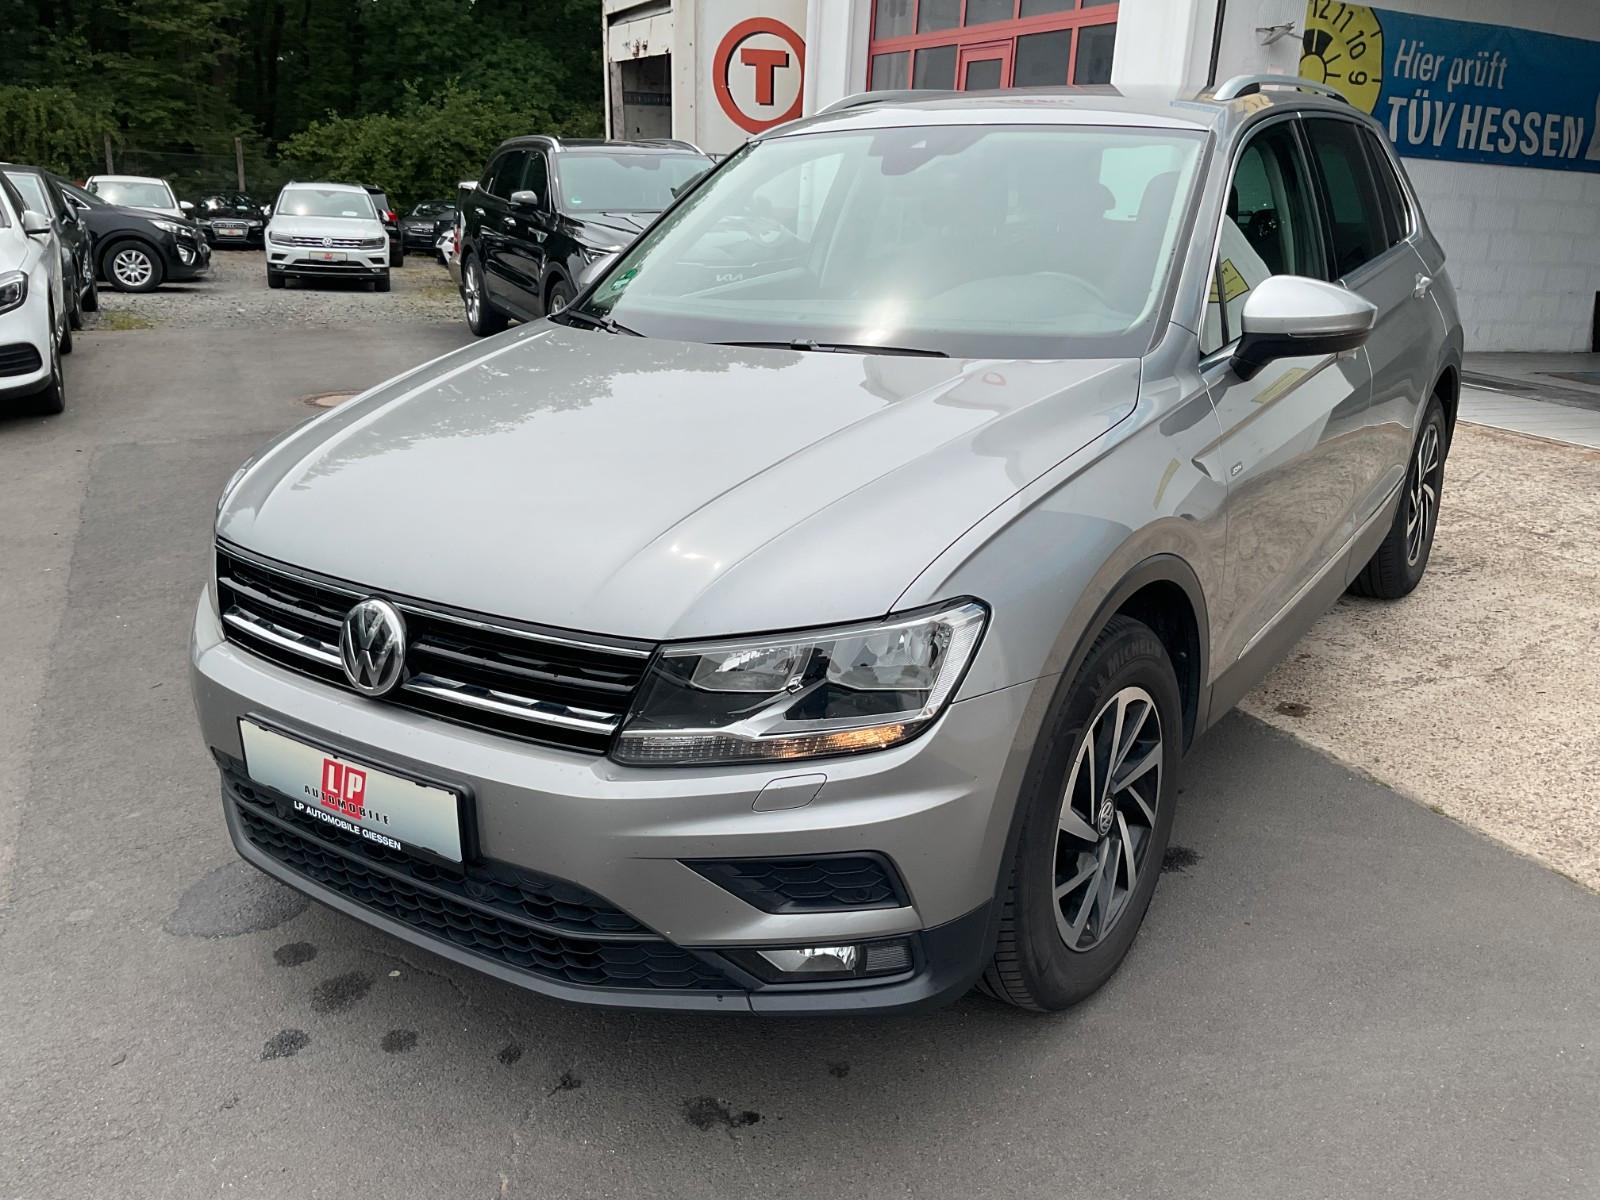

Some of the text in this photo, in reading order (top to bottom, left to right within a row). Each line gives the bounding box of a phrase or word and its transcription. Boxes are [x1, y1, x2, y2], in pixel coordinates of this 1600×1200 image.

[1332, 3, 1354, 32] 11
[1346, 30, 1366, 60] 10
[1393, 39, 1508, 93] Hier prüft
[740, 47, 789, 106] T
[1388, 89, 1584, 160] TÜV HESSEN
[327, 764, 363, 800] LP
[294, 801, 401, 850] LP AUTOMOBILE GIESSEN
[304, 785, 390, 825] AUTOMOBILE
